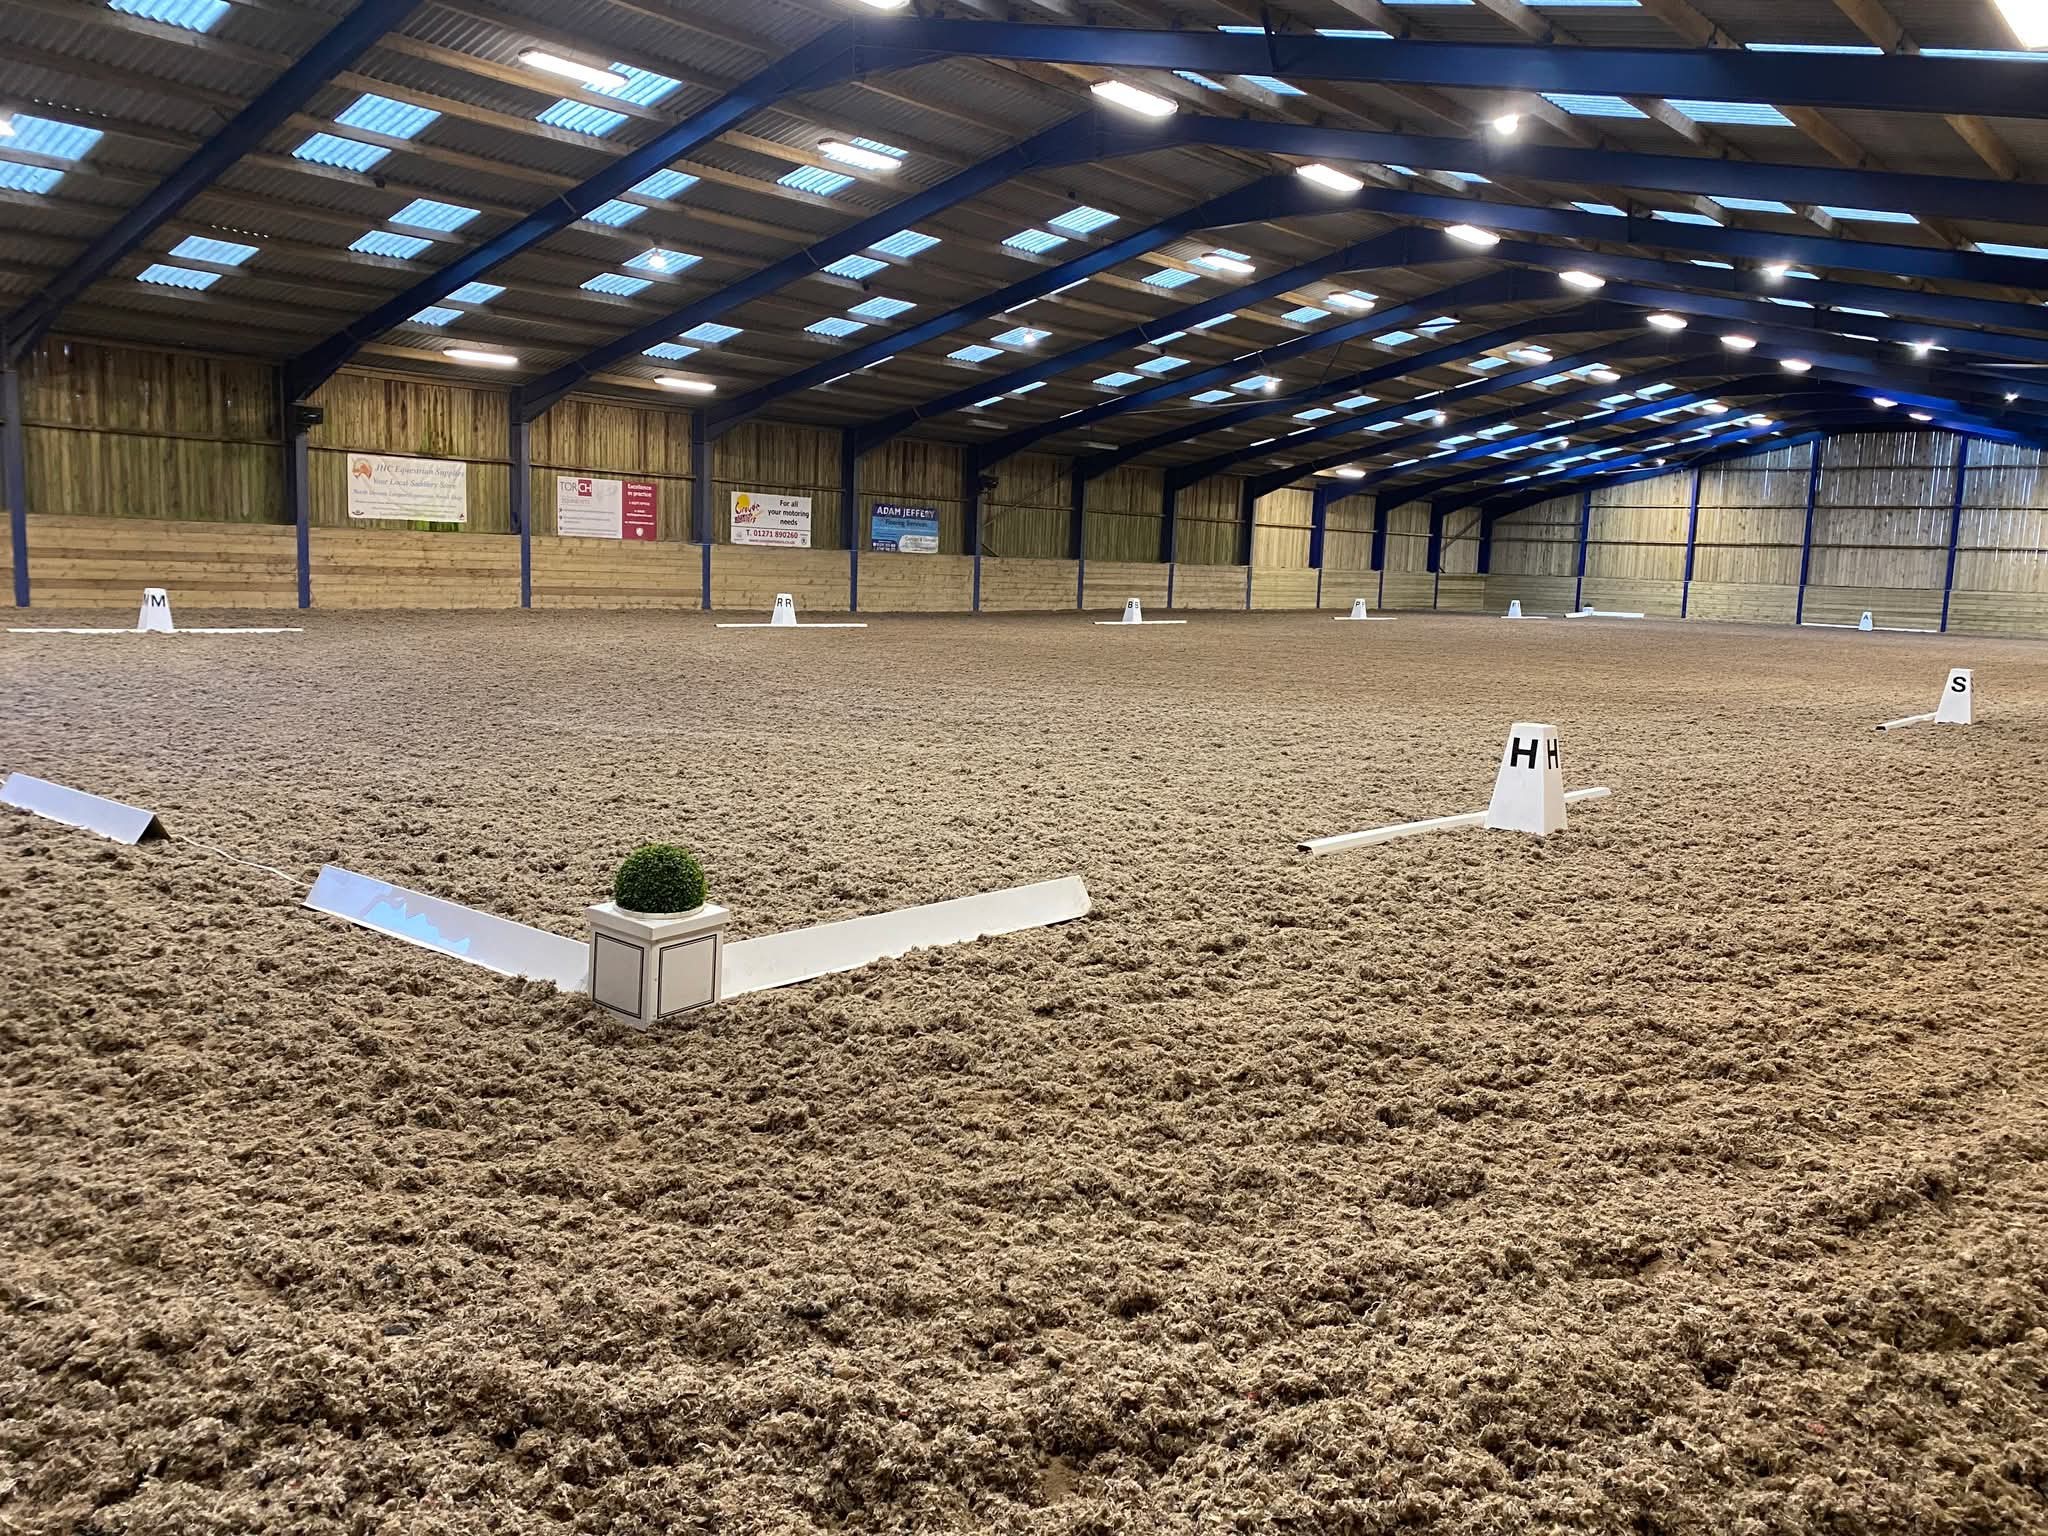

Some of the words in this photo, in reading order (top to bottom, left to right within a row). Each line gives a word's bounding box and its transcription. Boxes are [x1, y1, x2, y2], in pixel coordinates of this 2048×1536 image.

[395, 465, 434, 476] Equestrian
[390, 479, 409, 487] Local
[627, 483, 652, 491] Excellence
[782, 510, 810, 519] motoring
[876, 506, 901, 516] ADAM
[902, 508, 935, 518] JEFFERY
[774, 530, 799, 539] 890260
[151, 594, 166, 608] M
[785, 598, 792, 608] R
[1951, 676, 1967, 693] S
[1510, 737, 1539, 769] H
[1547, 738, 1559, 770] H
